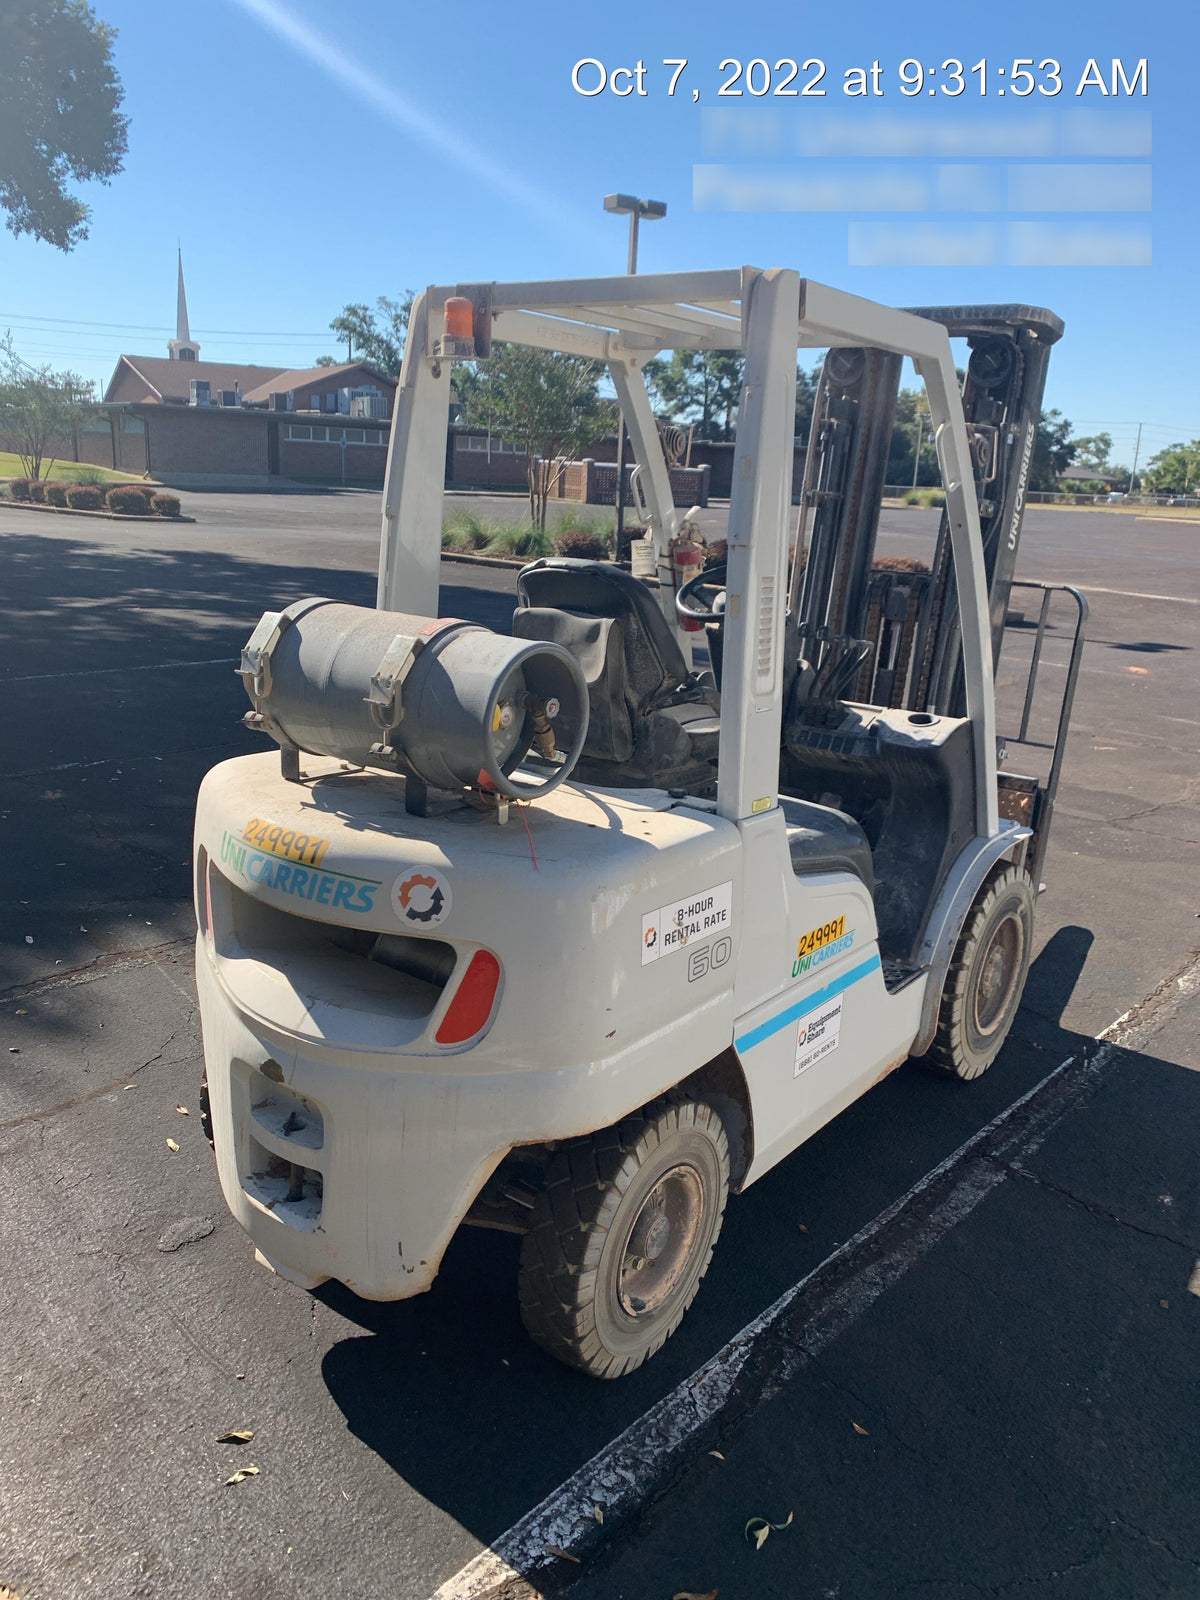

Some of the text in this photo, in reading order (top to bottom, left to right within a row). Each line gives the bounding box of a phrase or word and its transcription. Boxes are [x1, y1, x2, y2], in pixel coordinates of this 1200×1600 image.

[1008, 420, 1034, 550] UNICARRIERS
[242, 818, 323, 865] 249991
[220, 830, 379, 912] UNICARRIERS
[664, 910, 727, 946] RENTAL RATE
[677, 896, 714, 922] 8-HOUR
[791, 932, 855, 978] UNICARRIERS
[798, 915, 846, 957] 249991
[687, 935, 732, 983] 60
[807, 1026, 825, 1043] Share
[808, 1004, 841, 1033] Equipment
